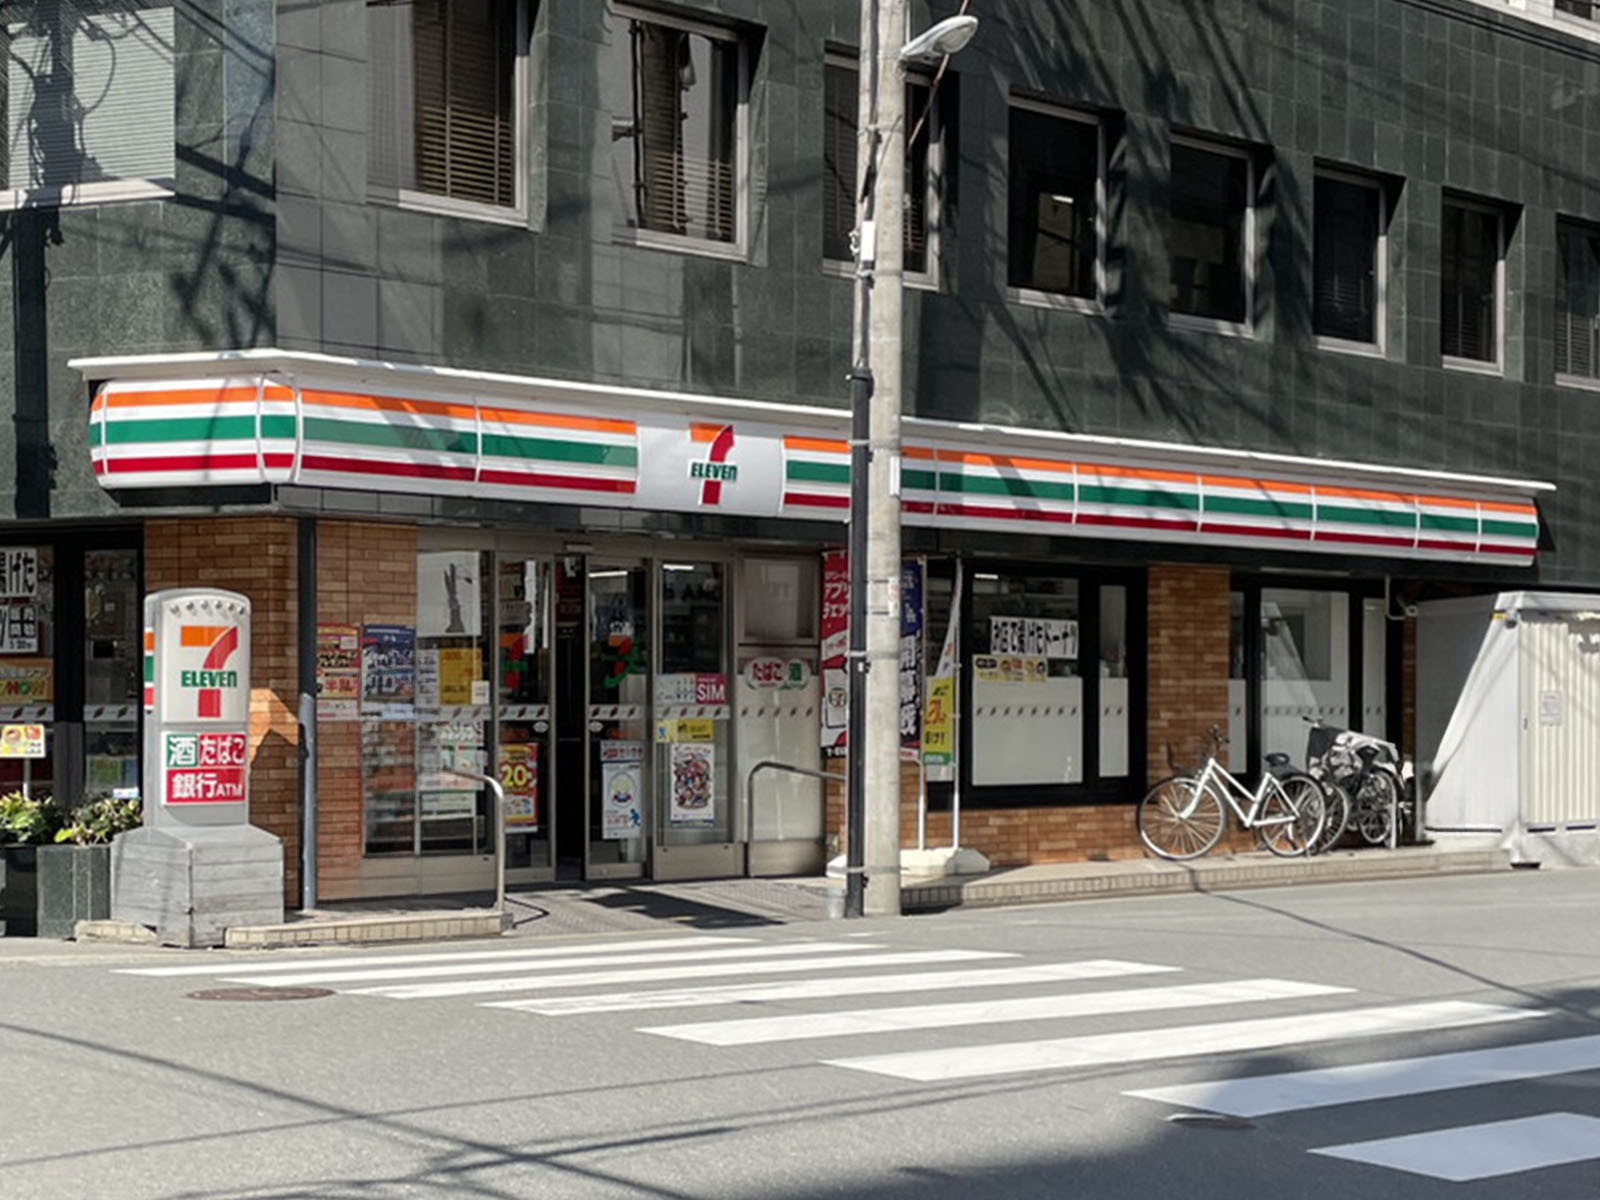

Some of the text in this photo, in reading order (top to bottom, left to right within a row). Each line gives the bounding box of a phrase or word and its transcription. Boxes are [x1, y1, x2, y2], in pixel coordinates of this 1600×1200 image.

[753, 661, 784, 681] たばこ
[697, 683, 725, 701] SIM
[169, 735, 245, 766] 酒 たばこ
